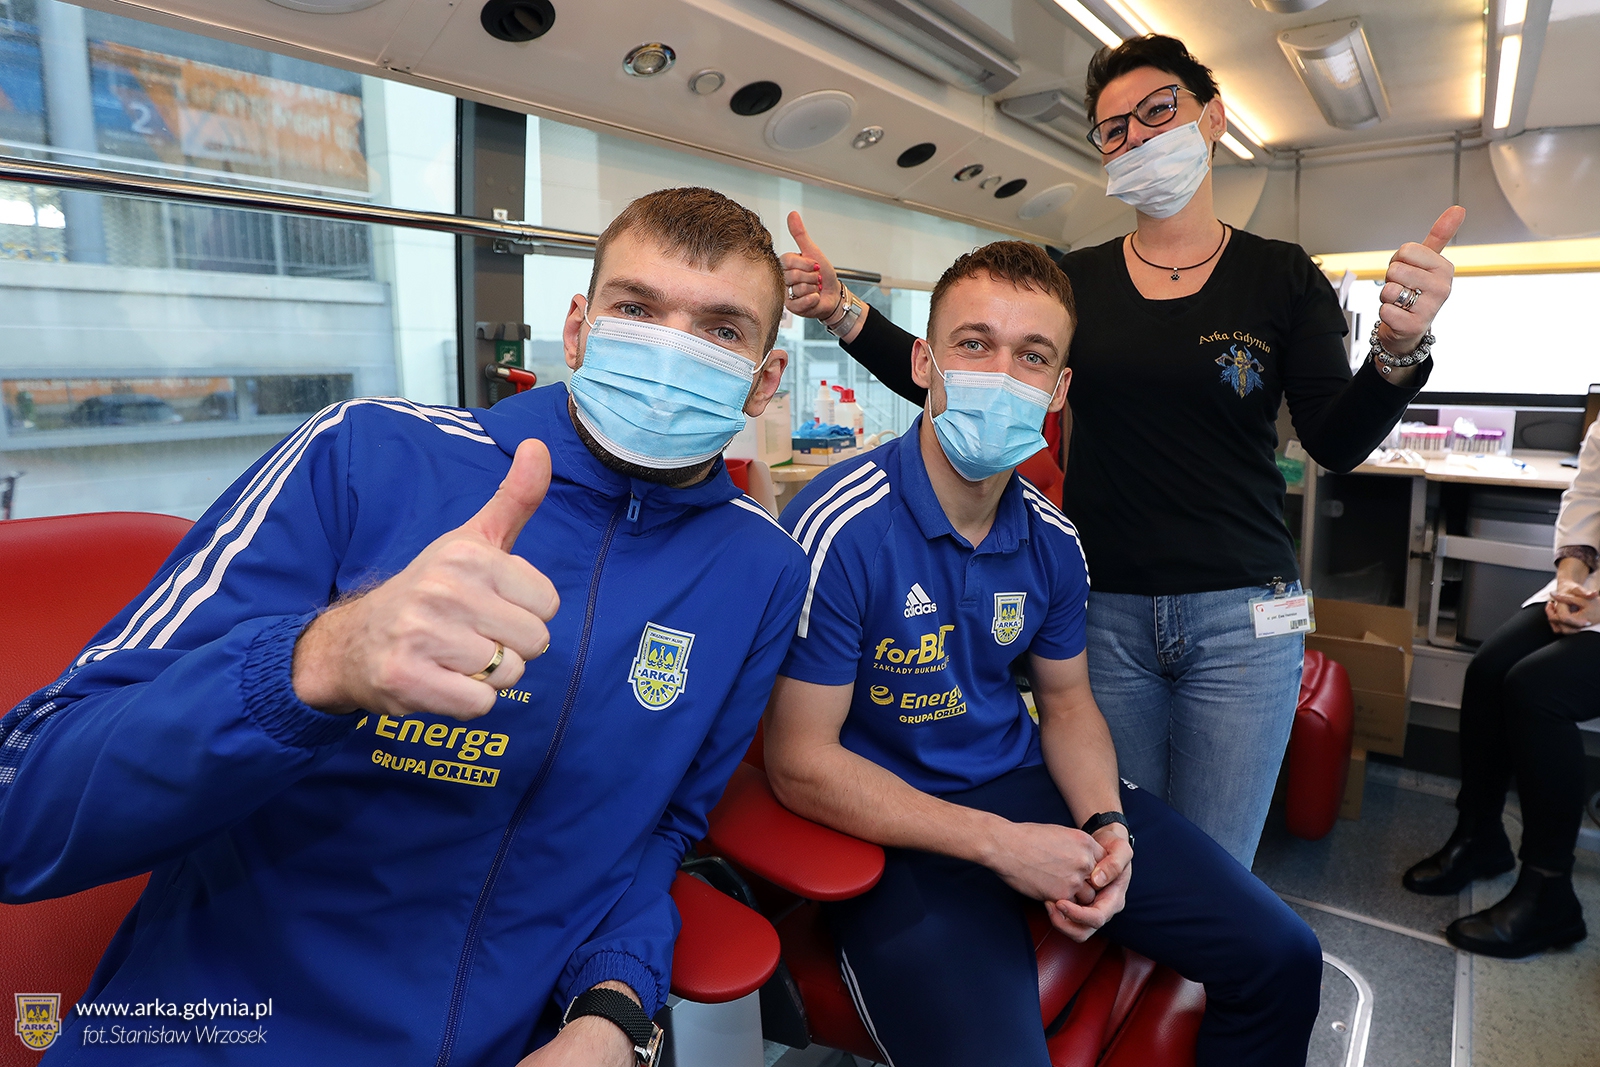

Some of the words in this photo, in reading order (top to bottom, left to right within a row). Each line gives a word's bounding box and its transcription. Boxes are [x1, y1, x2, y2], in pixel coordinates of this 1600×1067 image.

[131, 102, 154, 134] 2
[1199, 331, 1230, 345] Arka
[1233, 331, 1271, 353] Gdynia
[903, 602, 937, 618] adidas
[640, 669, 676, 683] ARKA
[873, 662, 913, 675] ZAKŁADY
[899, 713, 934, 724] GRUPA
[935, 704, 966, 719] ORLEN
[375, 714, 510, 761] Energa
[371, 749, 426, 775] GRUPA
[432, 762, 496, 785] ORLEN
